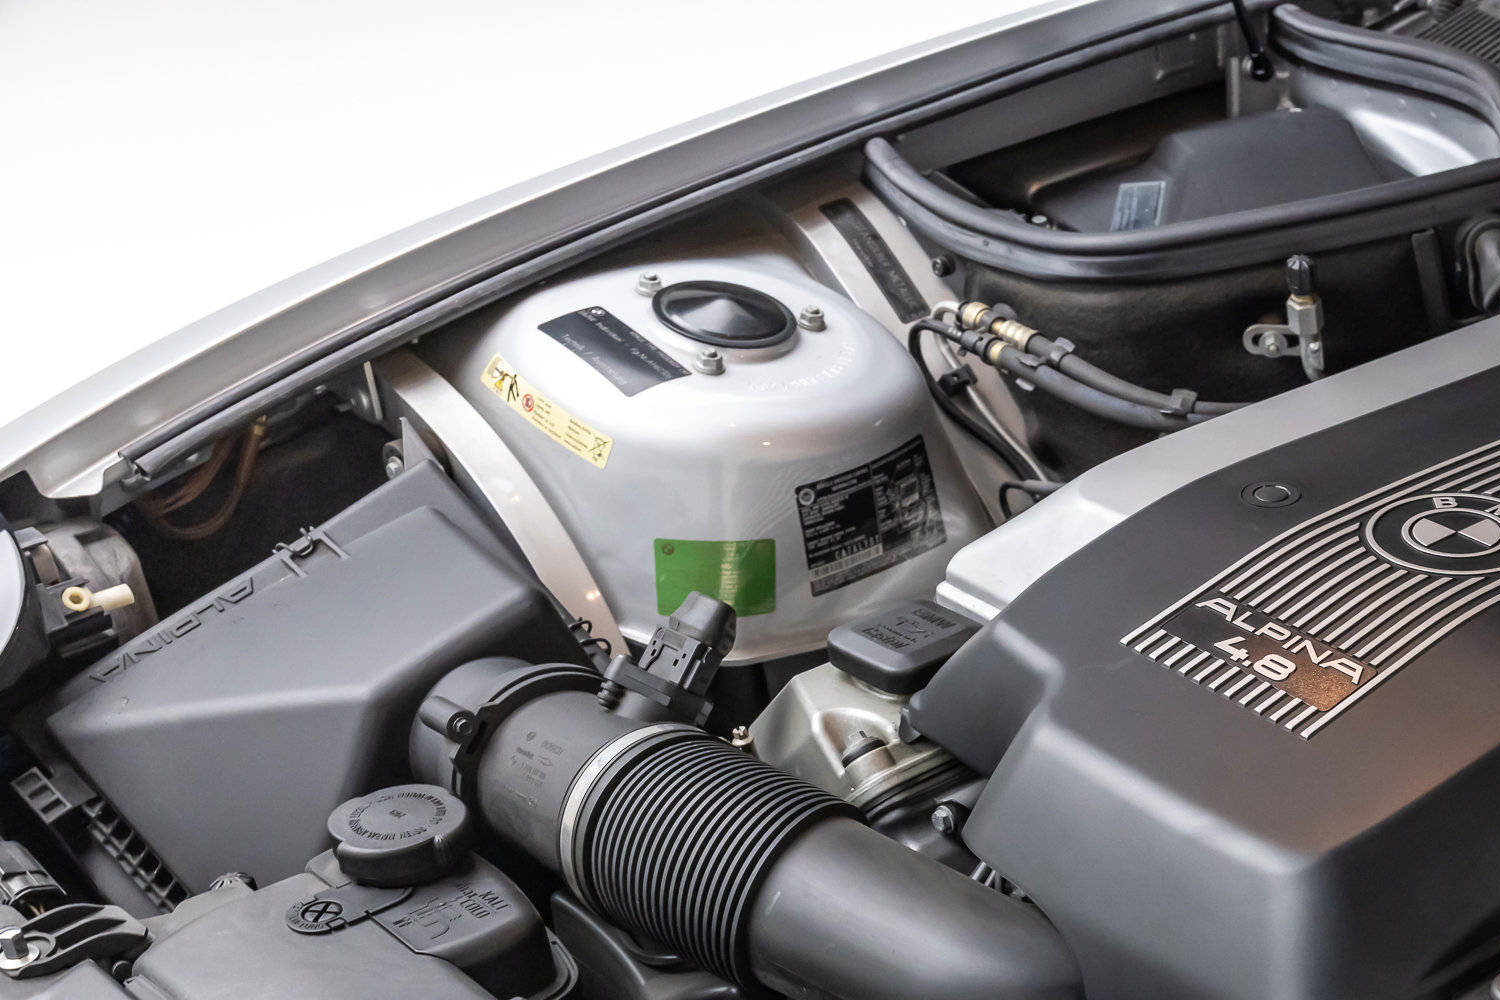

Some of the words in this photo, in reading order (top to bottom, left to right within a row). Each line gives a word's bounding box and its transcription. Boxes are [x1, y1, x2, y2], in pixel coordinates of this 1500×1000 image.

[88, 576, 254, 683] ALPINA
[1195, 597, 1378, 685] ALPINA
[1212, 636, 1296, 682] 4.8
